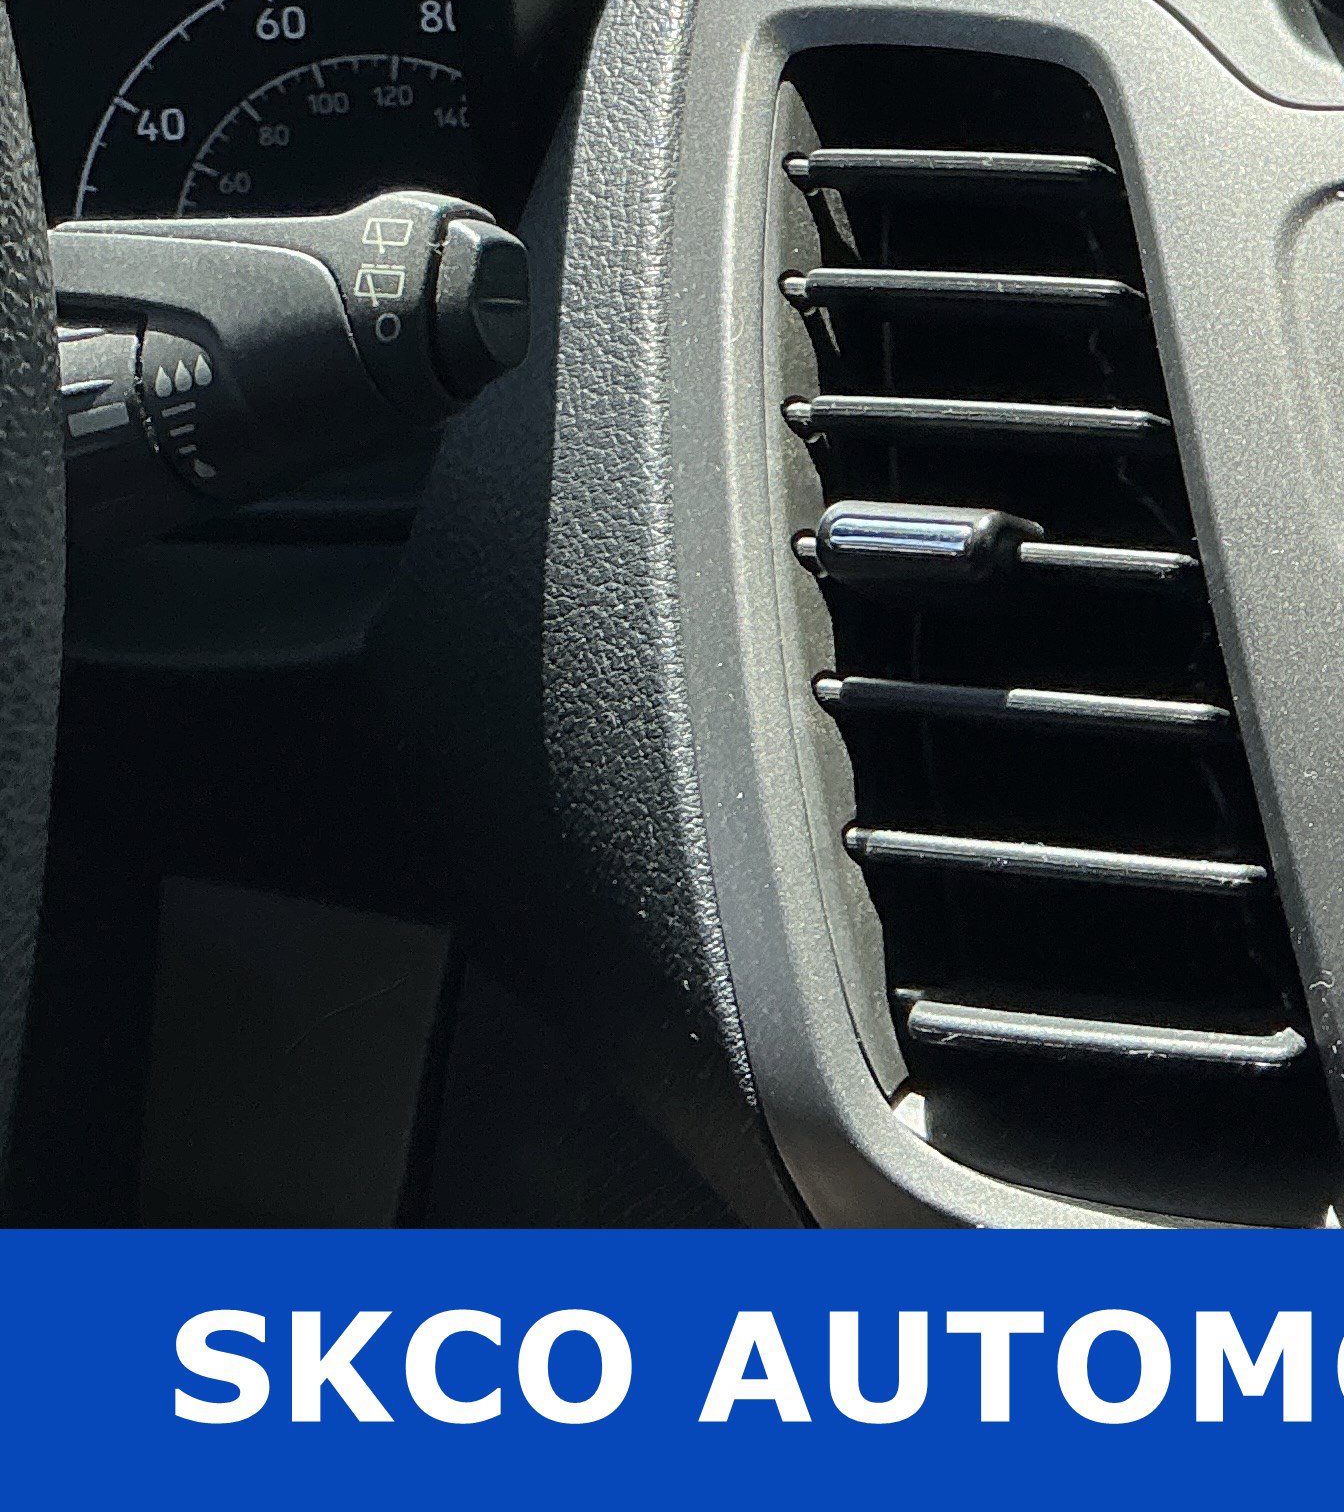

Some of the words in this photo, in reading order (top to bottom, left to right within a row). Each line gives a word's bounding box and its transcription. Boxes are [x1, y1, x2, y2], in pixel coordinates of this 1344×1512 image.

[256, 5, 306, 40] 60
[136, 107, 186, 142] 40
[258, 123, 290, 147] 80
[307, 91, 350, 115] 100
[373, 84, 414, 107] 120
[218, 171, 252, 194] 60
